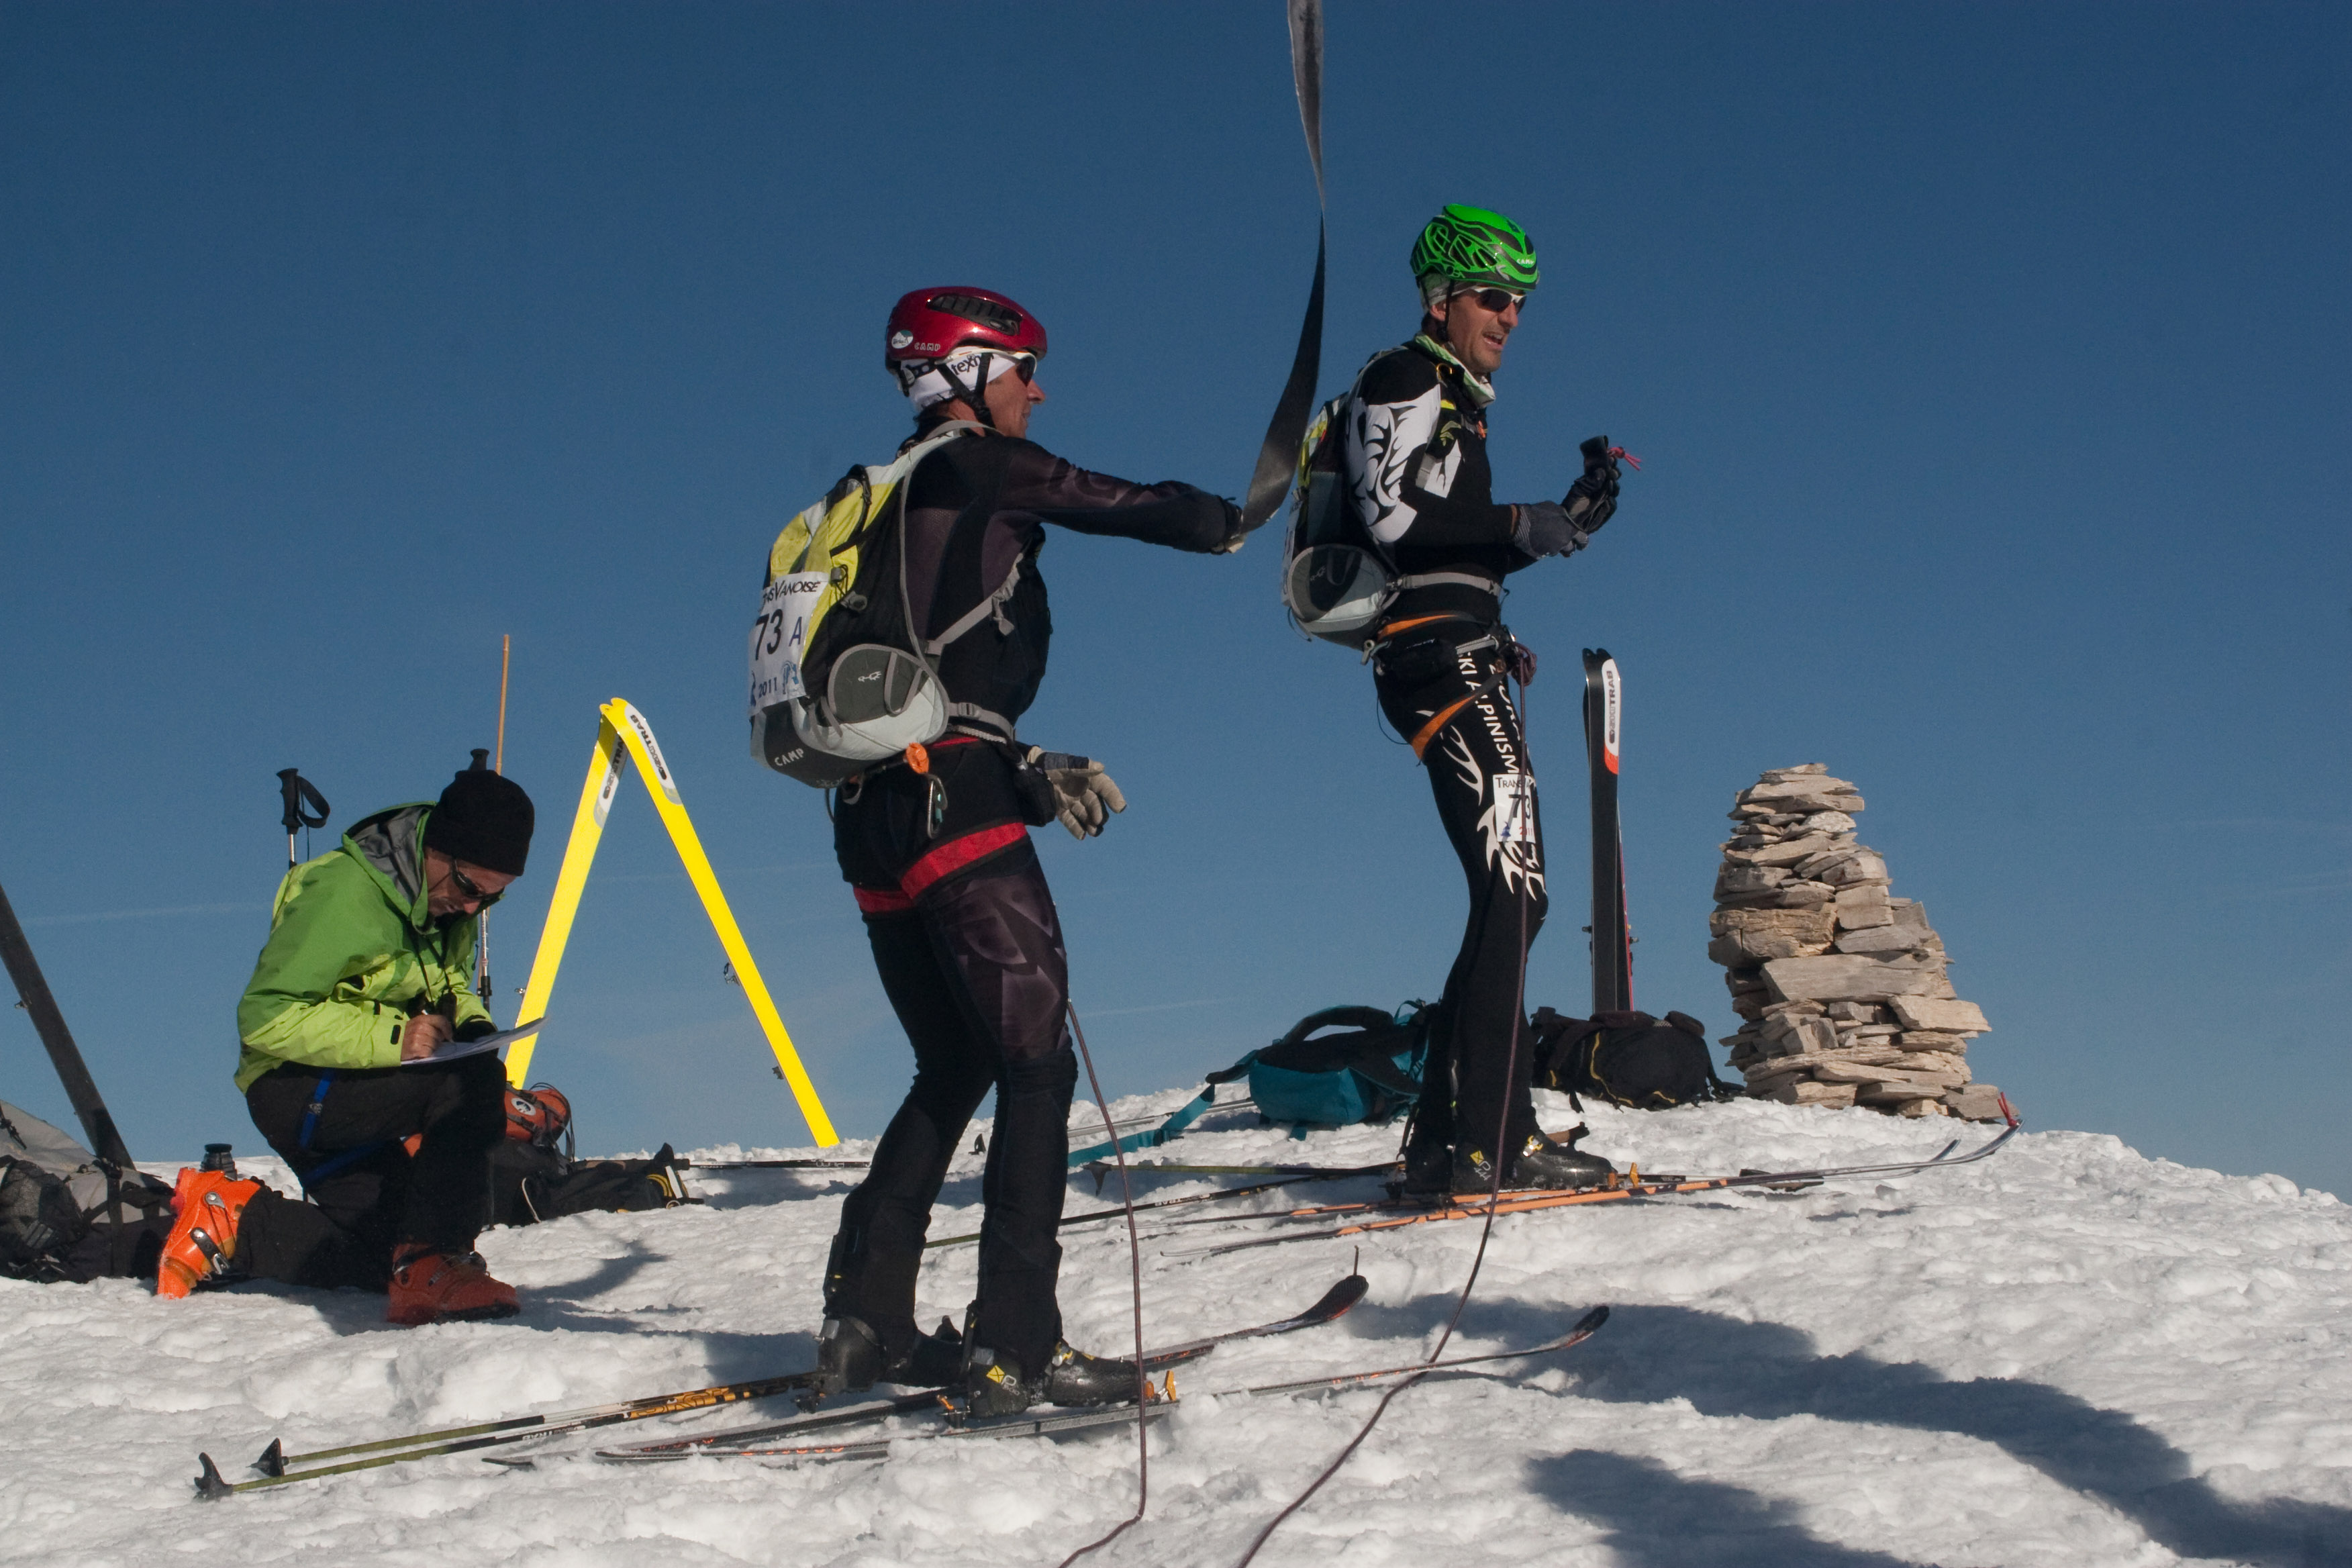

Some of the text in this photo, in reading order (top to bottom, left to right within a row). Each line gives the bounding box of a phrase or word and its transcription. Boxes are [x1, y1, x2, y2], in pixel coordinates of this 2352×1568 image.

[914, 342, 941, 352] CAMP
[754, 609, 803, 661] 73 A
[1457, 651, 1479, 675] KI
[758, 677, 777, 699] 2011
[775, 748, 804, 767] CAMP
[1519, 826, 1534, 836] 211
